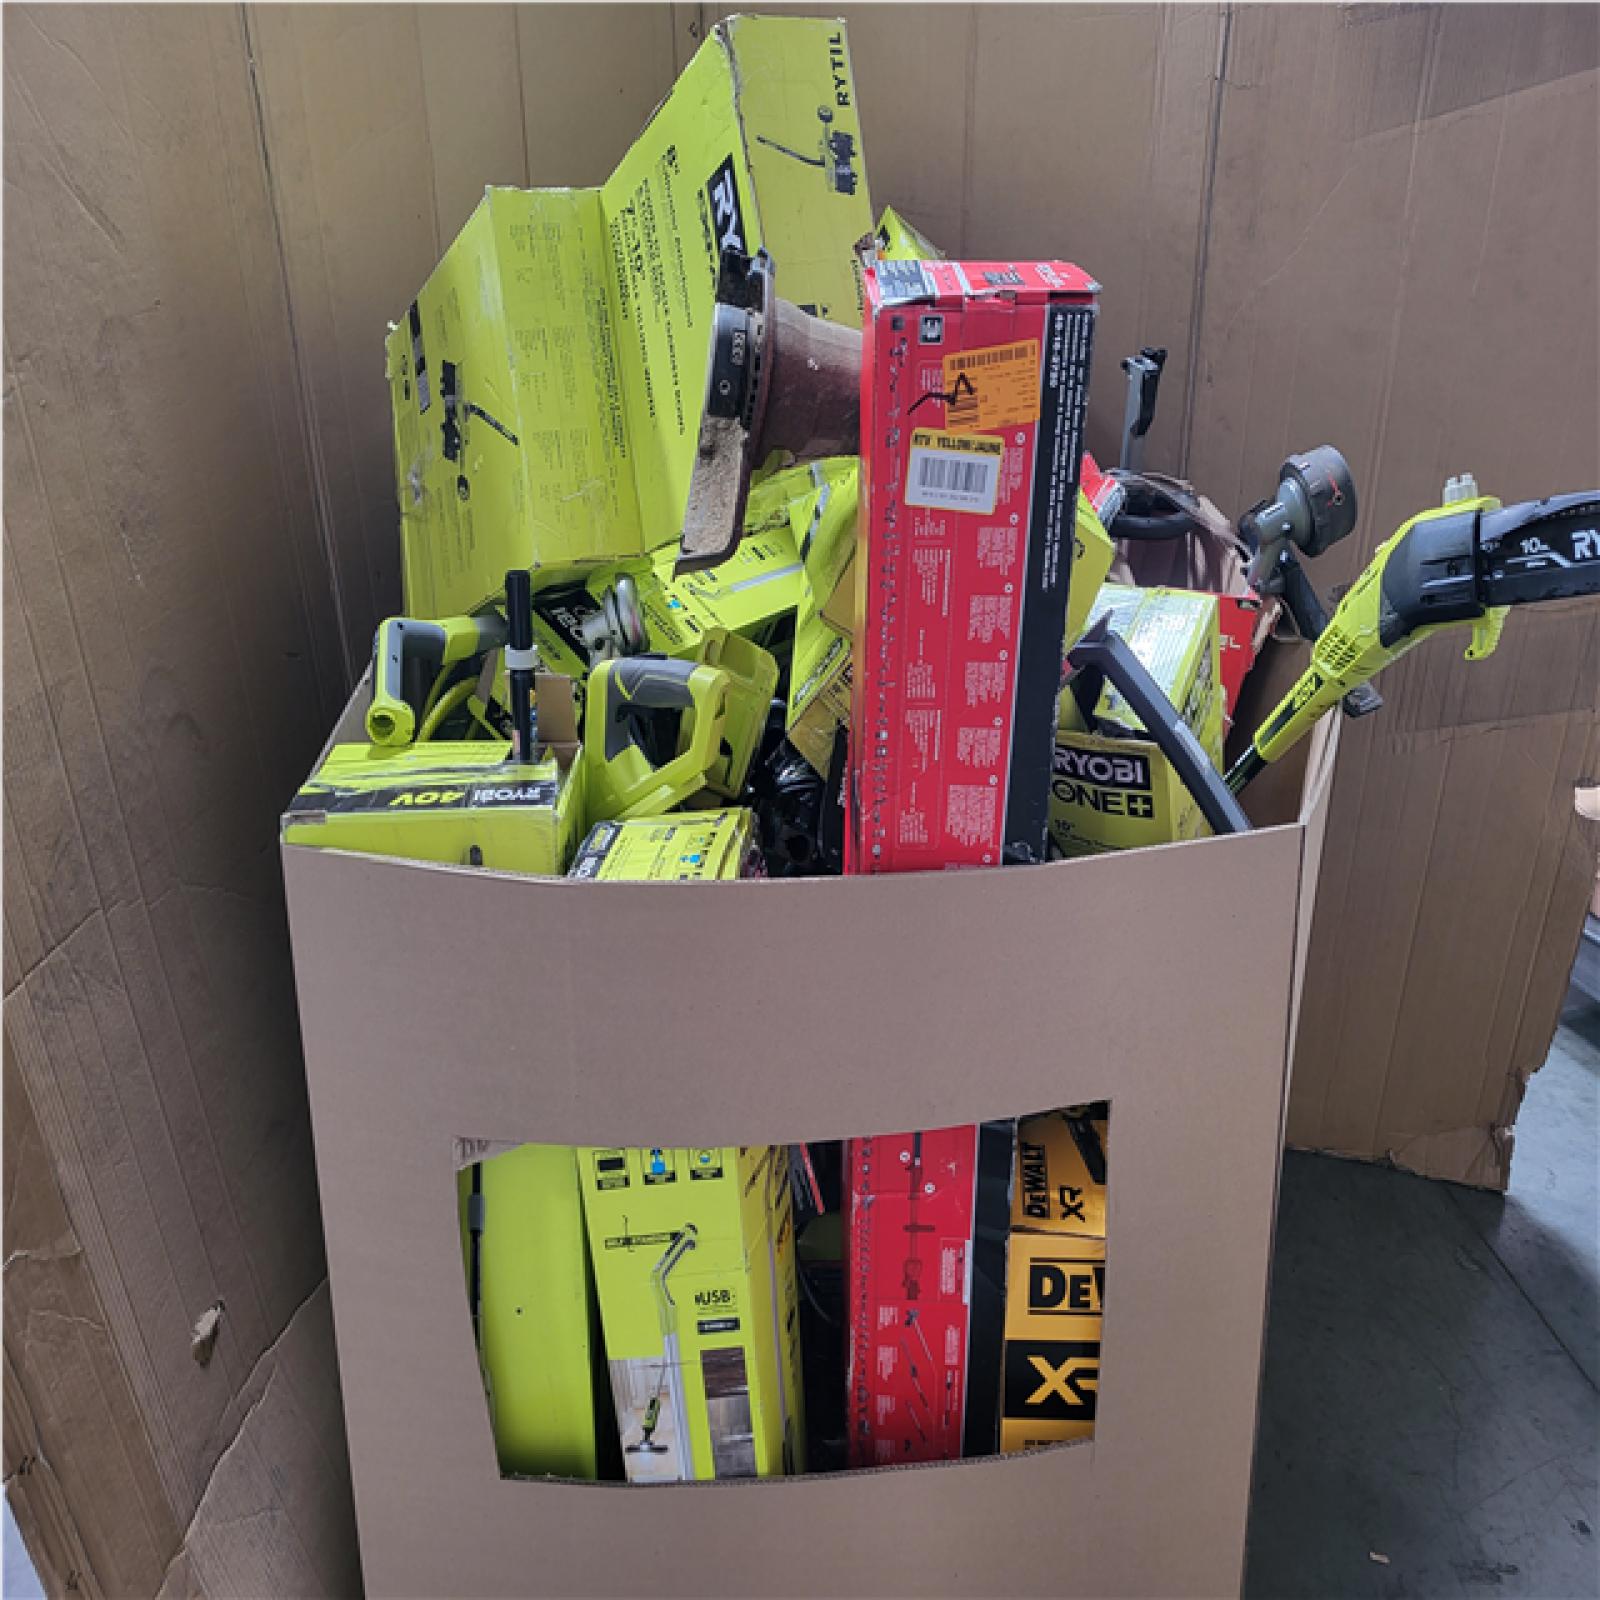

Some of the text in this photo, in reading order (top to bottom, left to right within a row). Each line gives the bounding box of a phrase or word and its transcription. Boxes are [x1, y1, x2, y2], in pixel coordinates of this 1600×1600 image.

[1053, 748, 1144, 784] RYOBI
[389, 791, 466, 807] 40V
[1022, 1143, 1047, 1218] DEWALT
[1059, 1185, 1086, 1222] XR
